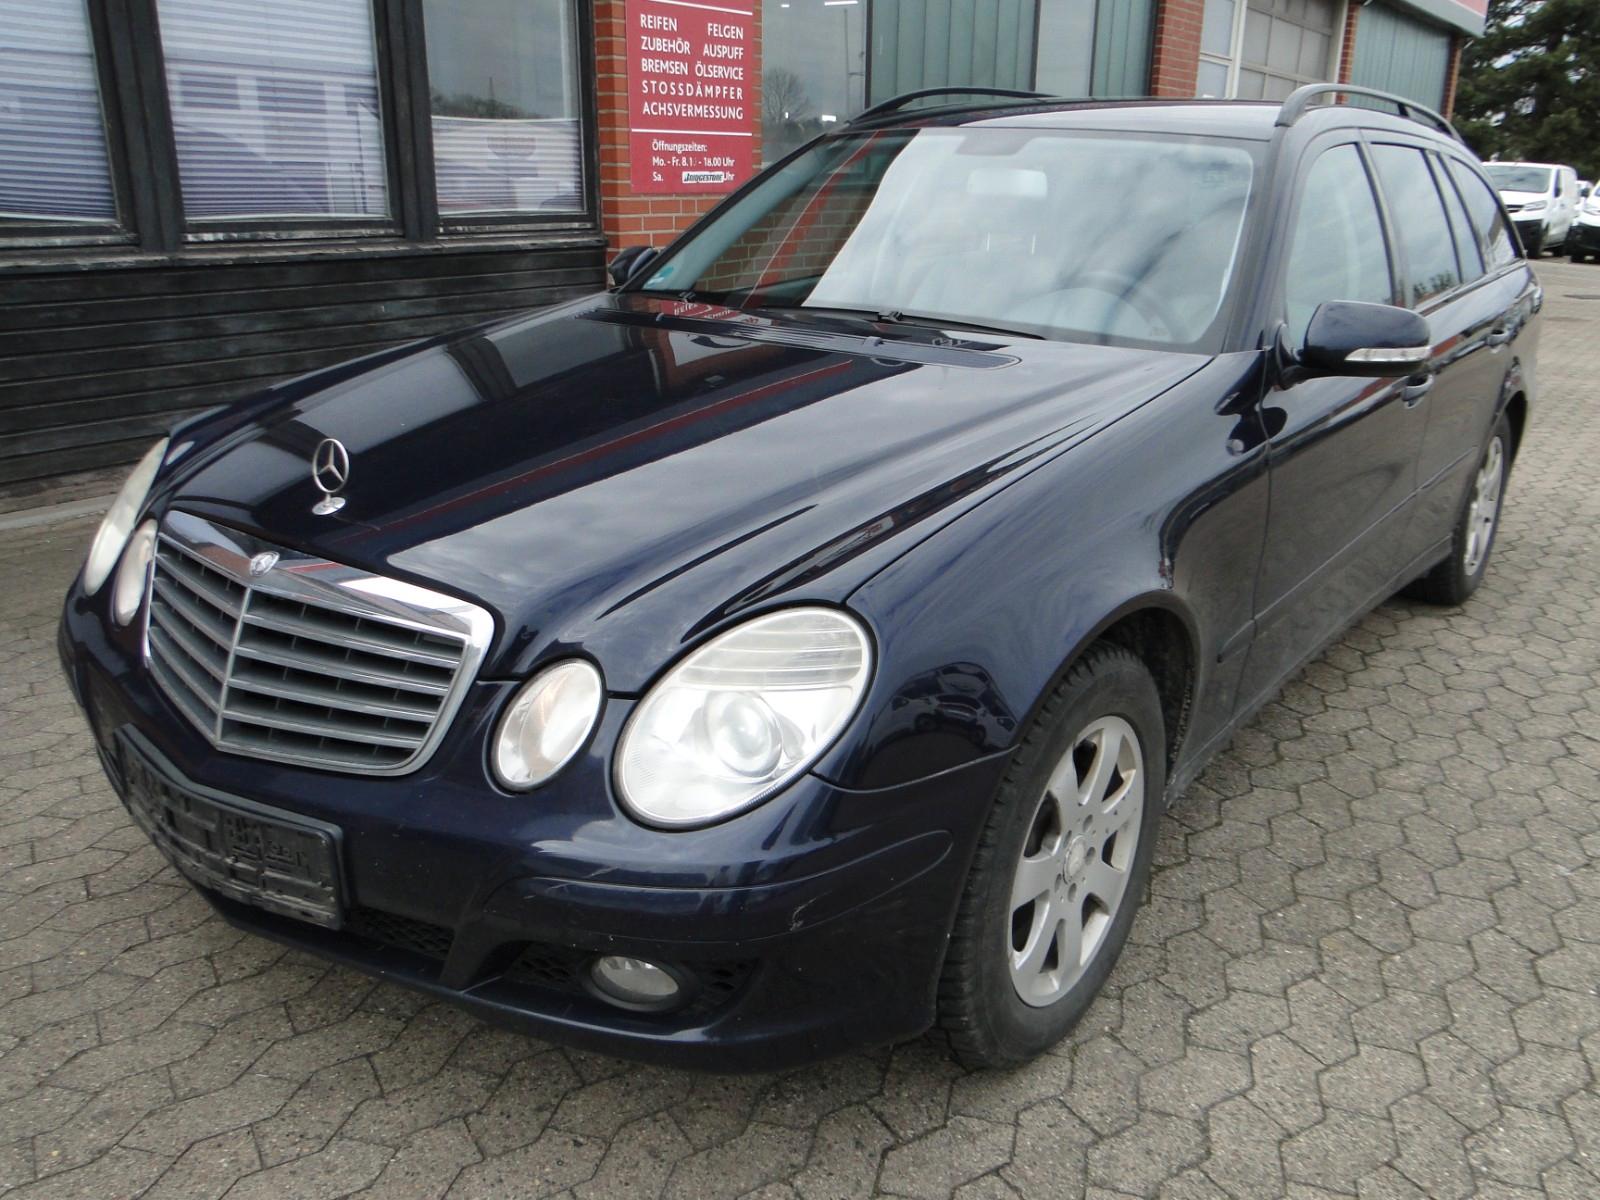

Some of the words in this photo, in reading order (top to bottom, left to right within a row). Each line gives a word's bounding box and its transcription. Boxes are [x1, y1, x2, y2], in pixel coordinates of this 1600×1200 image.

[640, 14, 678, 32] REIFEN
[707, 23, 744, 40] FELGEN
[641, 36, 691, 55] ZUBEHÖR
[703, 43, 744, 60] AUSPUFF
[641, 58, 688, 75] BREMSEN
[695, 61, 744, 80] ÖLSERVICE
[642, 80, 743, 100] STOSSDÄMPFER
[642, 102, 743, 119] ACHSVERMESSUNG
[652, 139, 707, 153] Öffnungszeiten:
[652, 156, 666, 166] Mo.
[672, 157, 681, 166] Fr.
[722, 156, 735, 167] Uhr
[652, 171, 664, 181] Sa.
